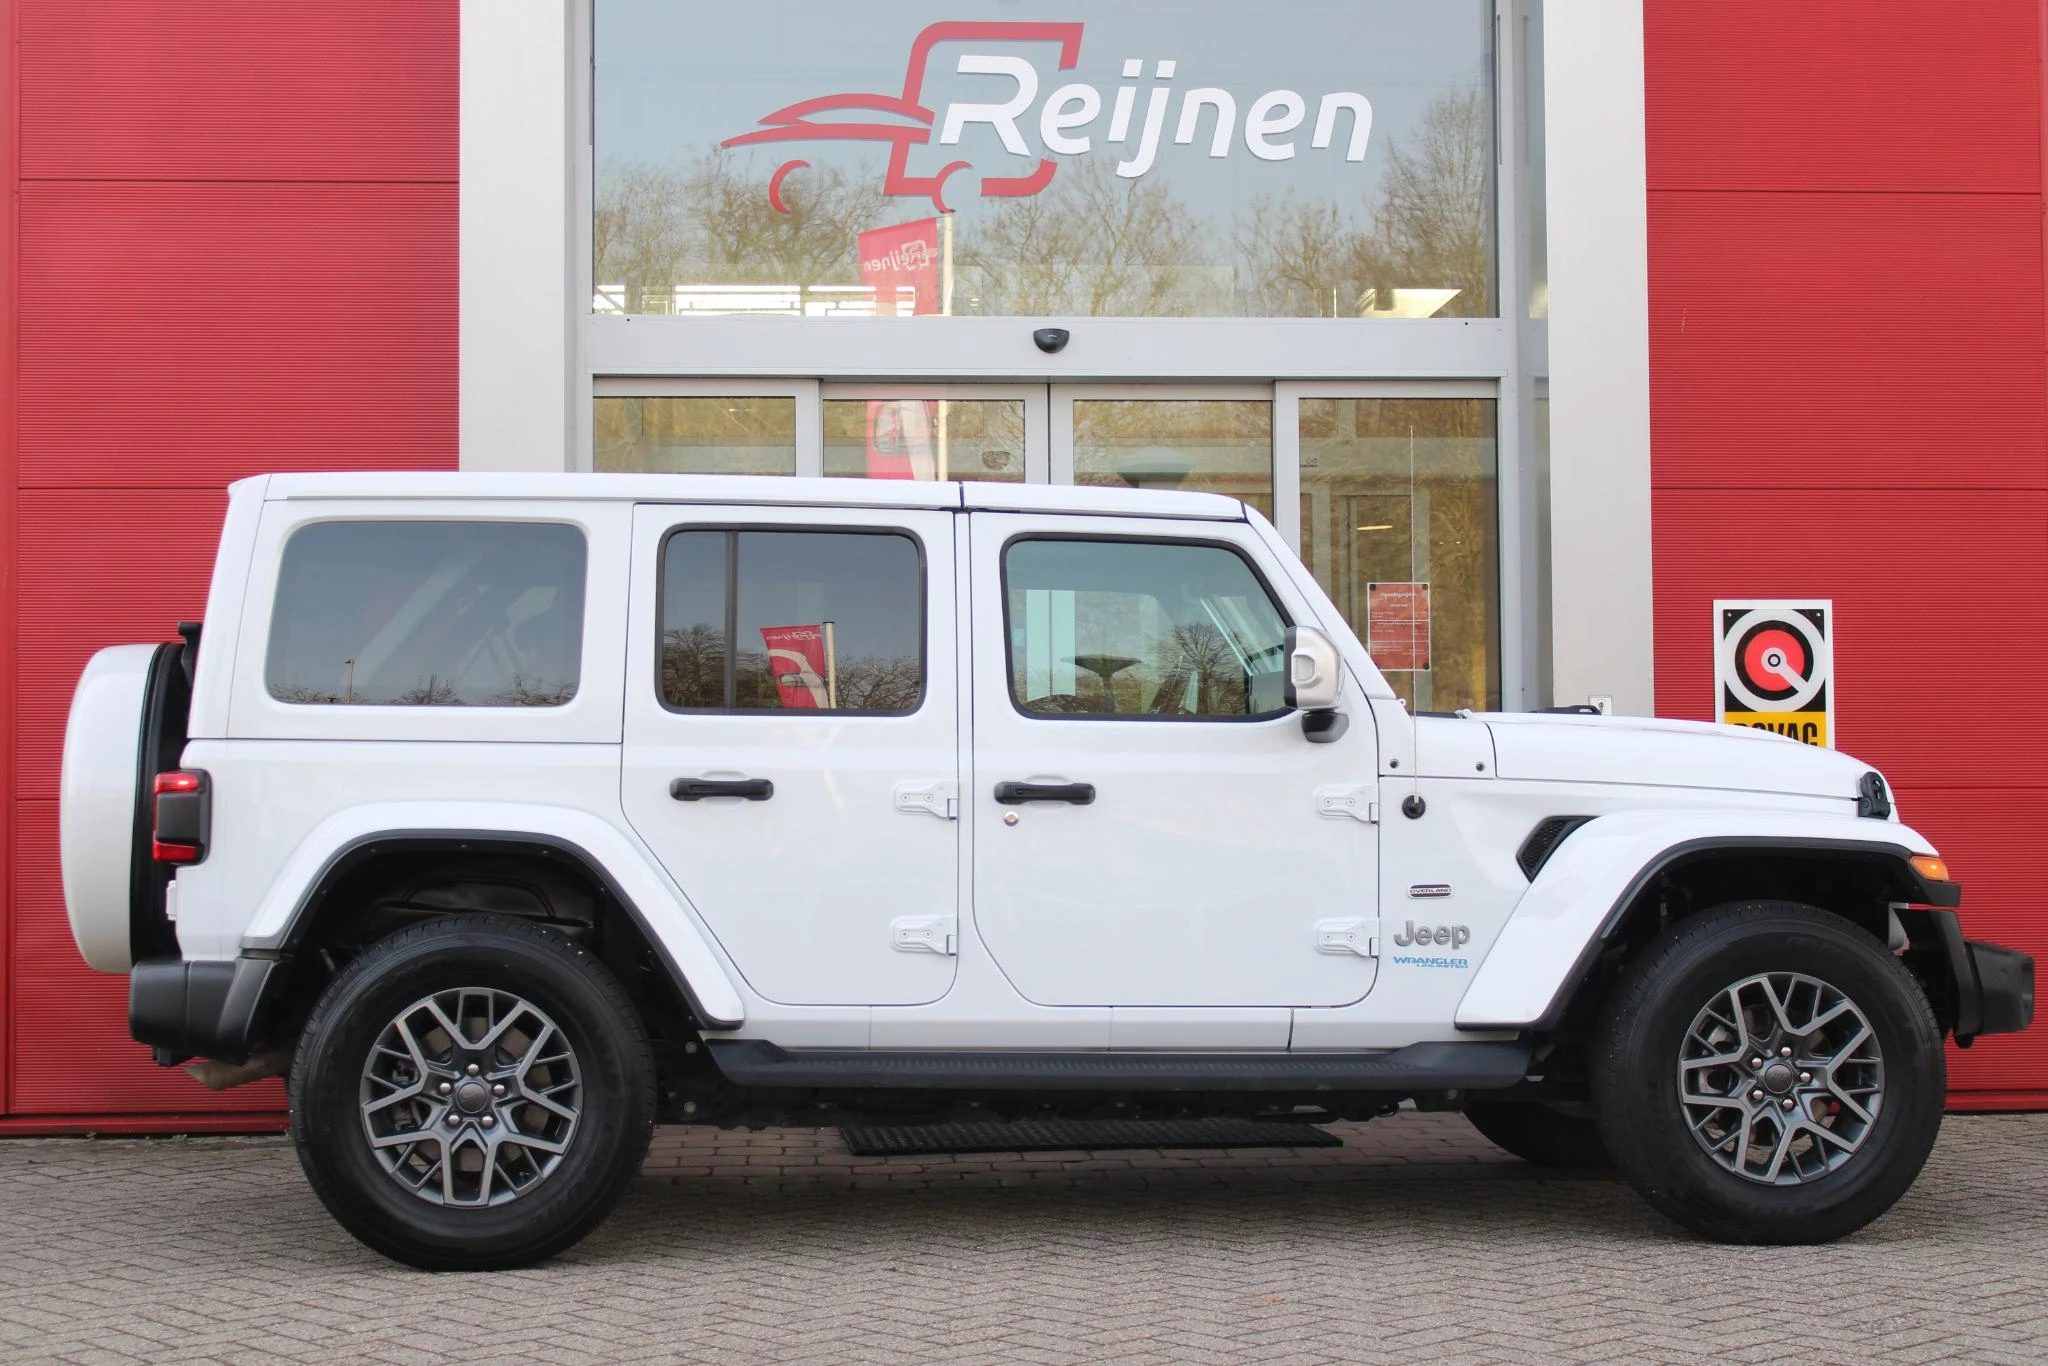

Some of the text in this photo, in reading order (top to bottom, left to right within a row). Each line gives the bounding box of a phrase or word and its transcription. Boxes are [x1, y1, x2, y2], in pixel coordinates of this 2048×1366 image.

[939, 54, 1373, 178] Reijnen
[1393, 919, 1470, 950] Jeep
[1393, 956, 1468, 965] WRANGLER
